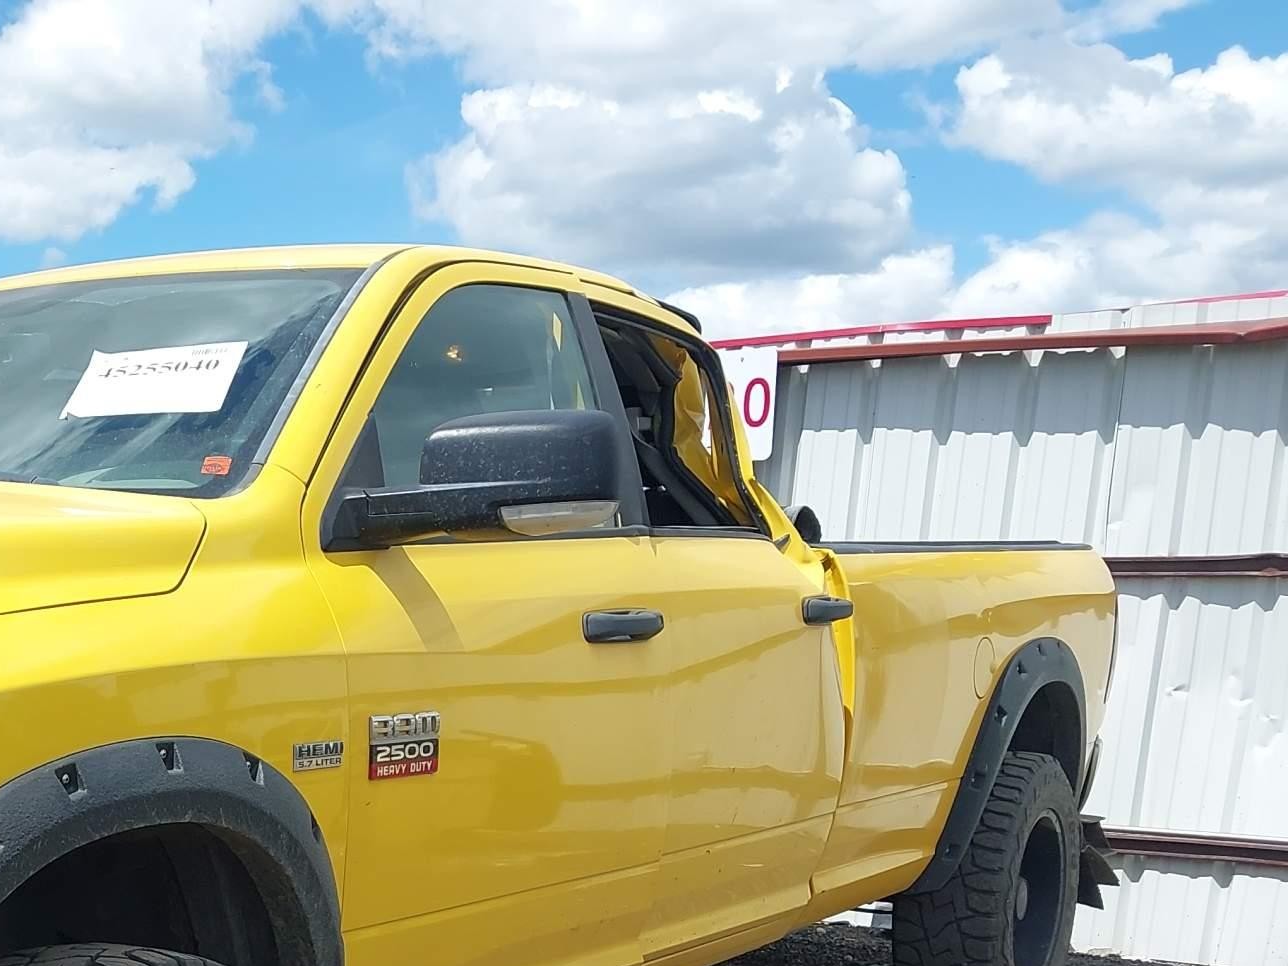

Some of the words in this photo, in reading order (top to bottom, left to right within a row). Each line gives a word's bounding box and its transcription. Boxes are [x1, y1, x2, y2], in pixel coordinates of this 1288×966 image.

[297, 741, 344, 758] HEMI
[376, 741, 434, 762] 2500
[298, 759, 313, 769] 5.7
[315, 758, 342, 768] LITER
[377, 763, 407, 777] HEAVY
[410, 760, 434, 773] DUTY
